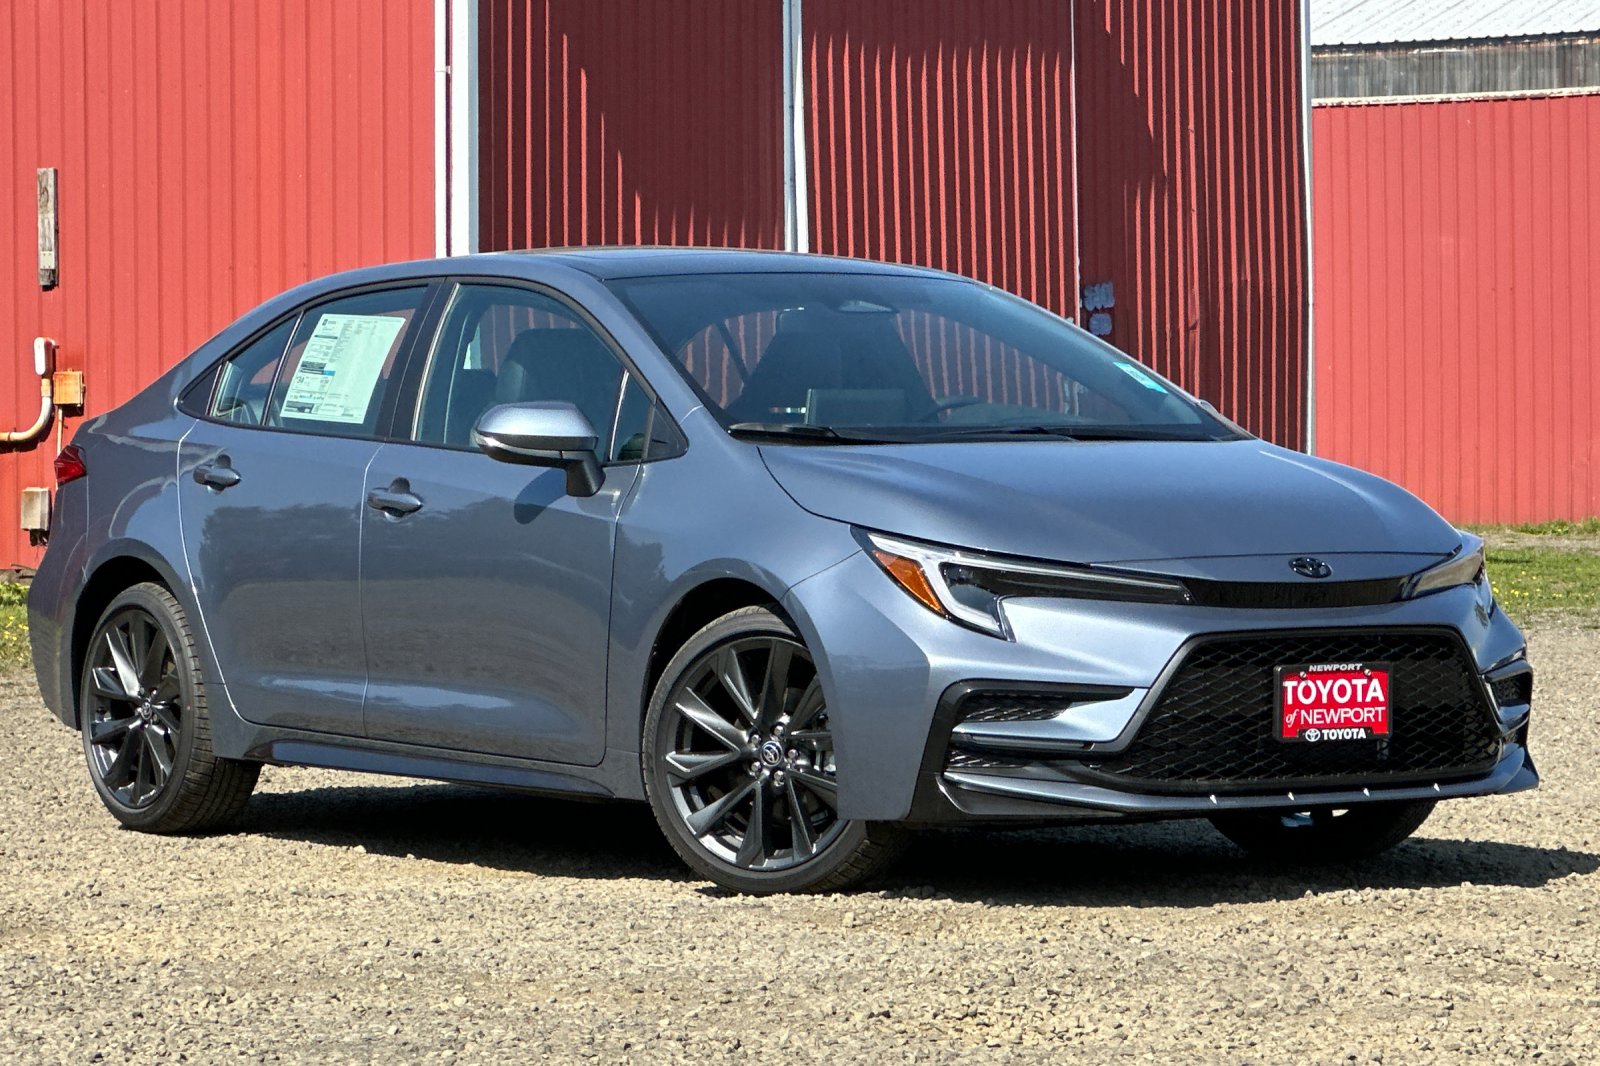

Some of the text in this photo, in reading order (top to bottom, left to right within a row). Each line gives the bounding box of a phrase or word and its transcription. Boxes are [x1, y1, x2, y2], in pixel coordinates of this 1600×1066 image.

[1308, 663, 1363, 672] NEWPORT
[1283, 678, 1385, 705] TOYOTA
[1285, 706, 1386, 728] of NEWPORT
[1322, 728, 1367, 741] TOYOTA
